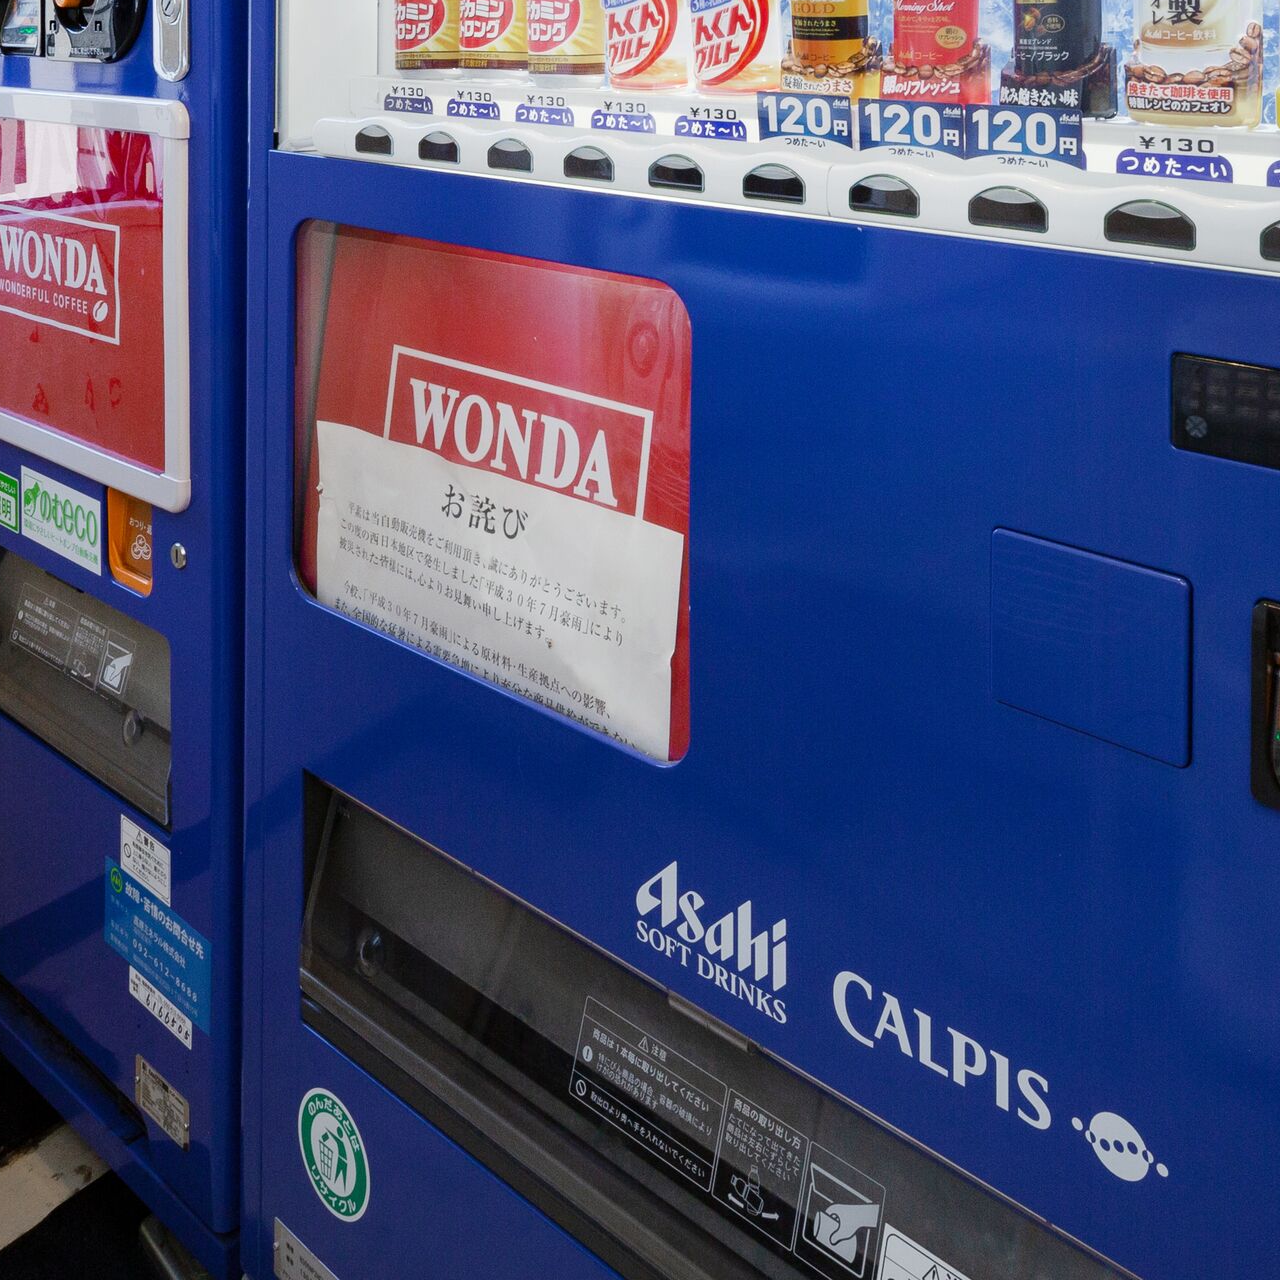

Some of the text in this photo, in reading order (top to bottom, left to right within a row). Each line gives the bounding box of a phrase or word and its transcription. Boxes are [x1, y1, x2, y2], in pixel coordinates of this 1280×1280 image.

[882, 74, 961, 96] 朝のリフレッシュ
[999, 85, 1079, 108] 飲み飽きない味
[762, 95, 849, 138] 120円
[864, 103, 960, 147] 120円
[972, 109, 1078, 156] 120円
[1139, 135, 1215, 152] ¥130
[52, 291, 89, 315] COFFEE
[409, 375, 619, 507] WONDA
[39, 489, 98, 547] のむeco
[440, 483, 530, 541] お詫び
[124, 880, 205, 960] 故障・苦情のお問合せ先
[635, 860, 789, 992] Asahi
[635, 918, 789, 1026] SOFT DRINKS
[591, 1027, 710, 1113] 商品は1本毎に取り出してください
[831, 970, 1053, 1133] CALPIS
[308, 1097, 360, 1152] のんだあとは
[733, 1097, 801, 1151] 商品の取り出し方
[311, 1164, 357, 1214] リサイクル
